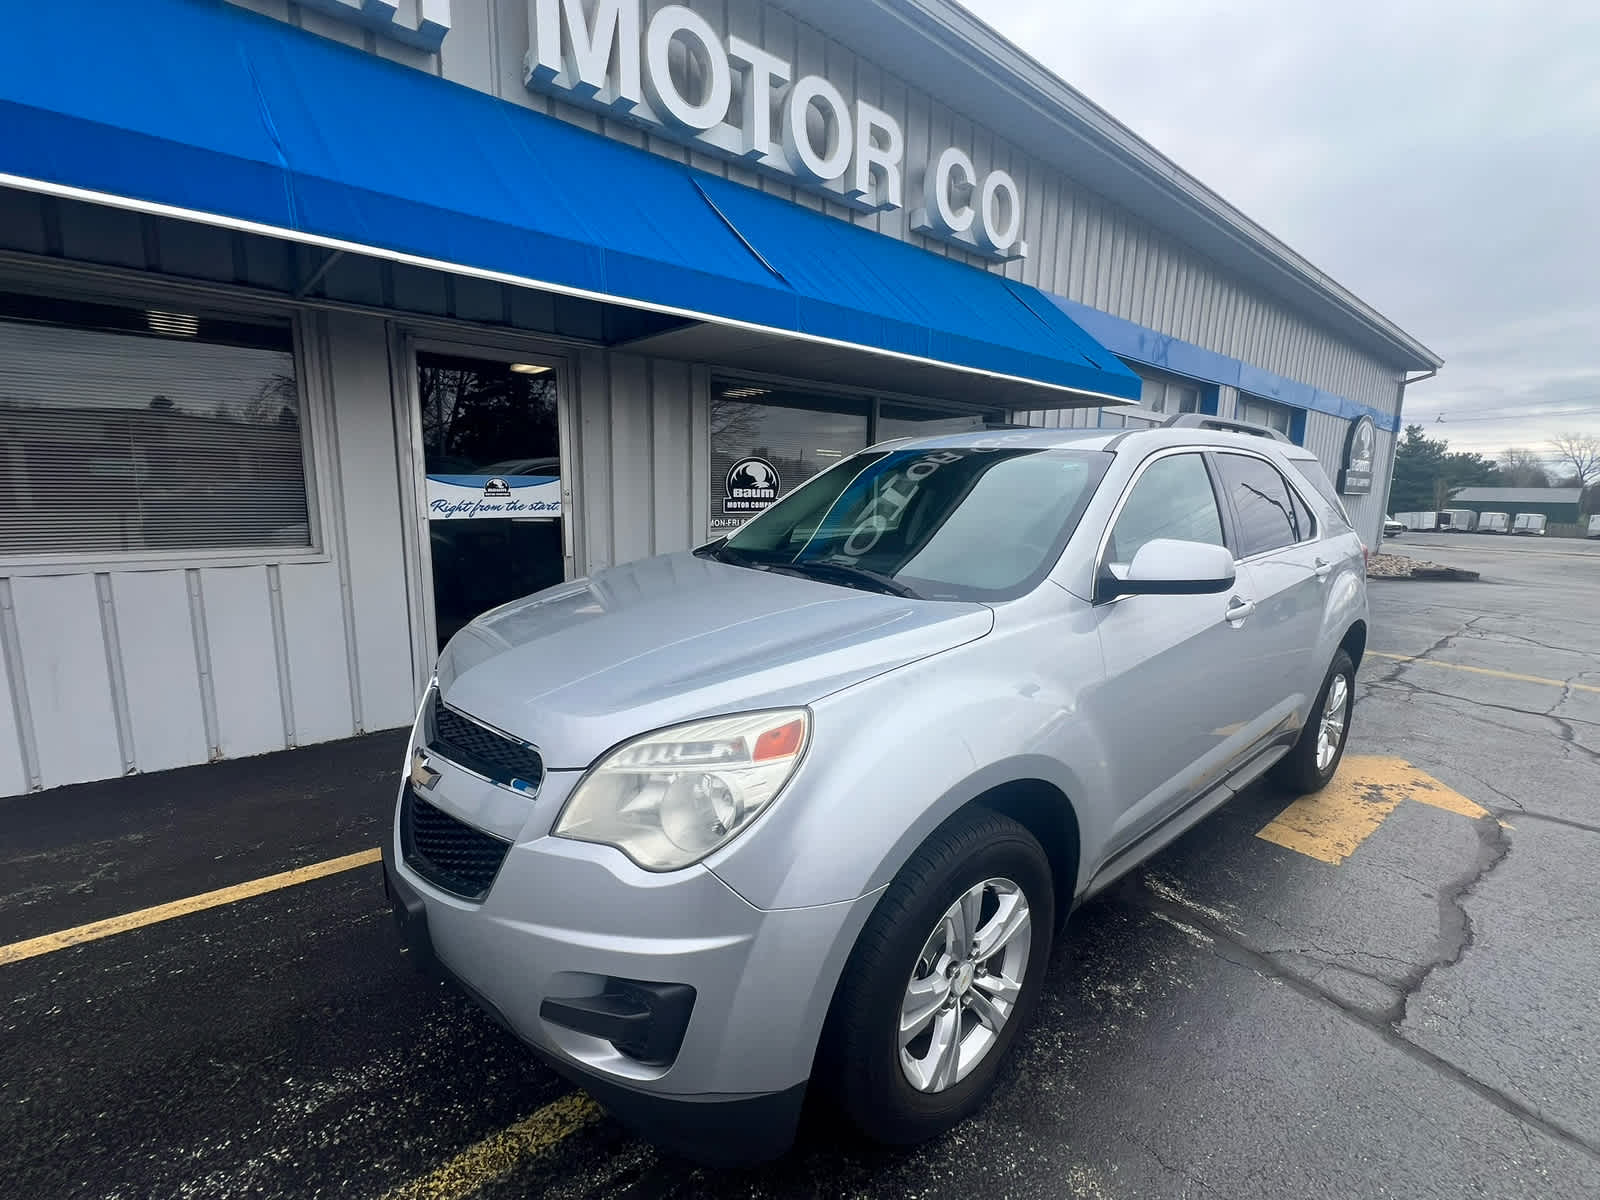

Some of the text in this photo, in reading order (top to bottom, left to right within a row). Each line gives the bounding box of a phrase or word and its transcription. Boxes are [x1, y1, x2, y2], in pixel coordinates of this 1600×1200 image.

[533, 0, 903, 209] MOTOR
[430, 498, 473, 518] Right
[468, 499, 504, 517] from
[503, 499, 527, 512] the
[727, 501, 750, 509] MOTOR
